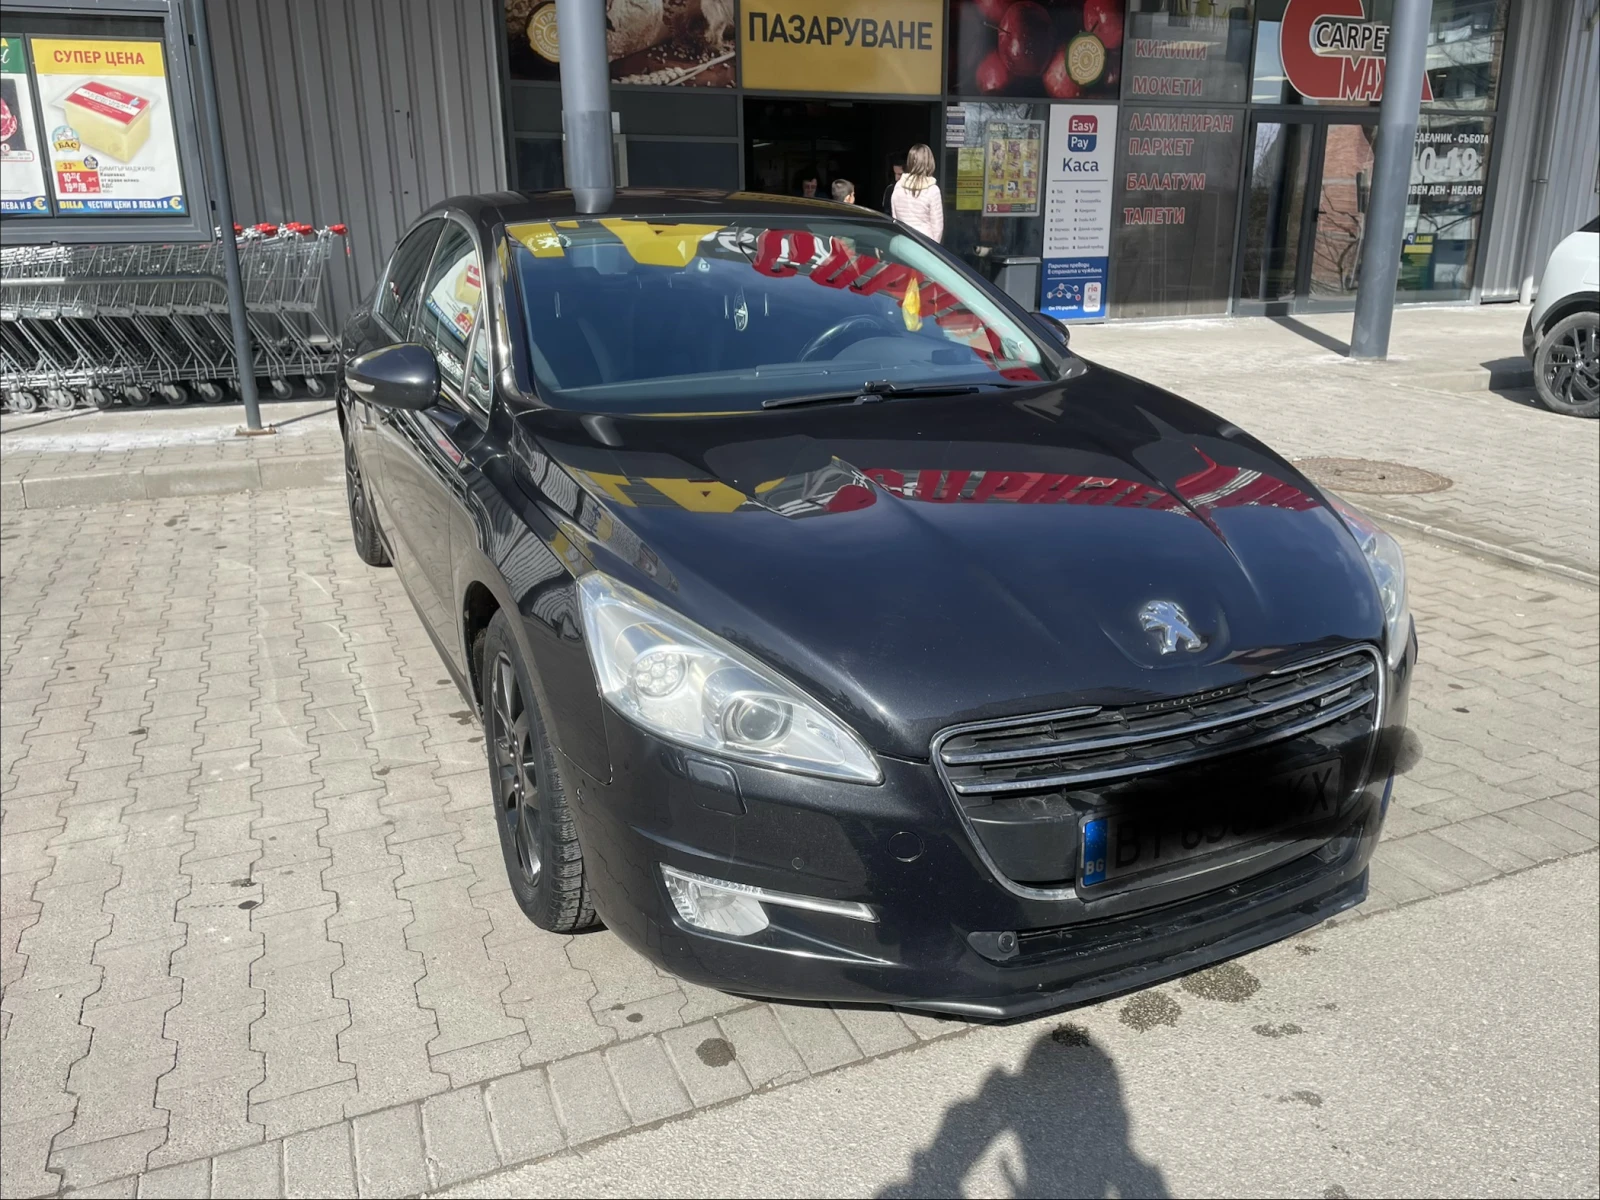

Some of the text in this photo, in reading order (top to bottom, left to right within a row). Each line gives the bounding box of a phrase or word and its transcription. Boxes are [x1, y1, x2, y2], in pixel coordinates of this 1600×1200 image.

[749, 11, 933, 50] ПАЗАРУВАНЕ
[1135, 38, 1208, 61] КИЛИМИ
[53, 50, 145, 67] СУПЕР ЦЕНА
[1132, 75, 1203, 96] МОКЕТИ
[1072, 119, 1095, 133] Easy
[1129, 112, 1234, 133] ЛАМИНИРАН
[1071, 136, 1089, 150] Pay
[1128, 137, 1195, 156] ПАРКЕТ
[1458, 134, 1489, 144] СЪБОТА
[1062, 157, 1099, 172] Каса
[1126, 172, 1206, 191] БАЛАТУМ
[1428, 186, 1446, 197] ДЕН
[1451, 185, 1483, 195] НЕДЕЛЯ
[59, 200, 84, 209] BILLA
[1123, 207, 1186, 225] ТАПЕТИ
[1086, 859, 1105, 875] BG
